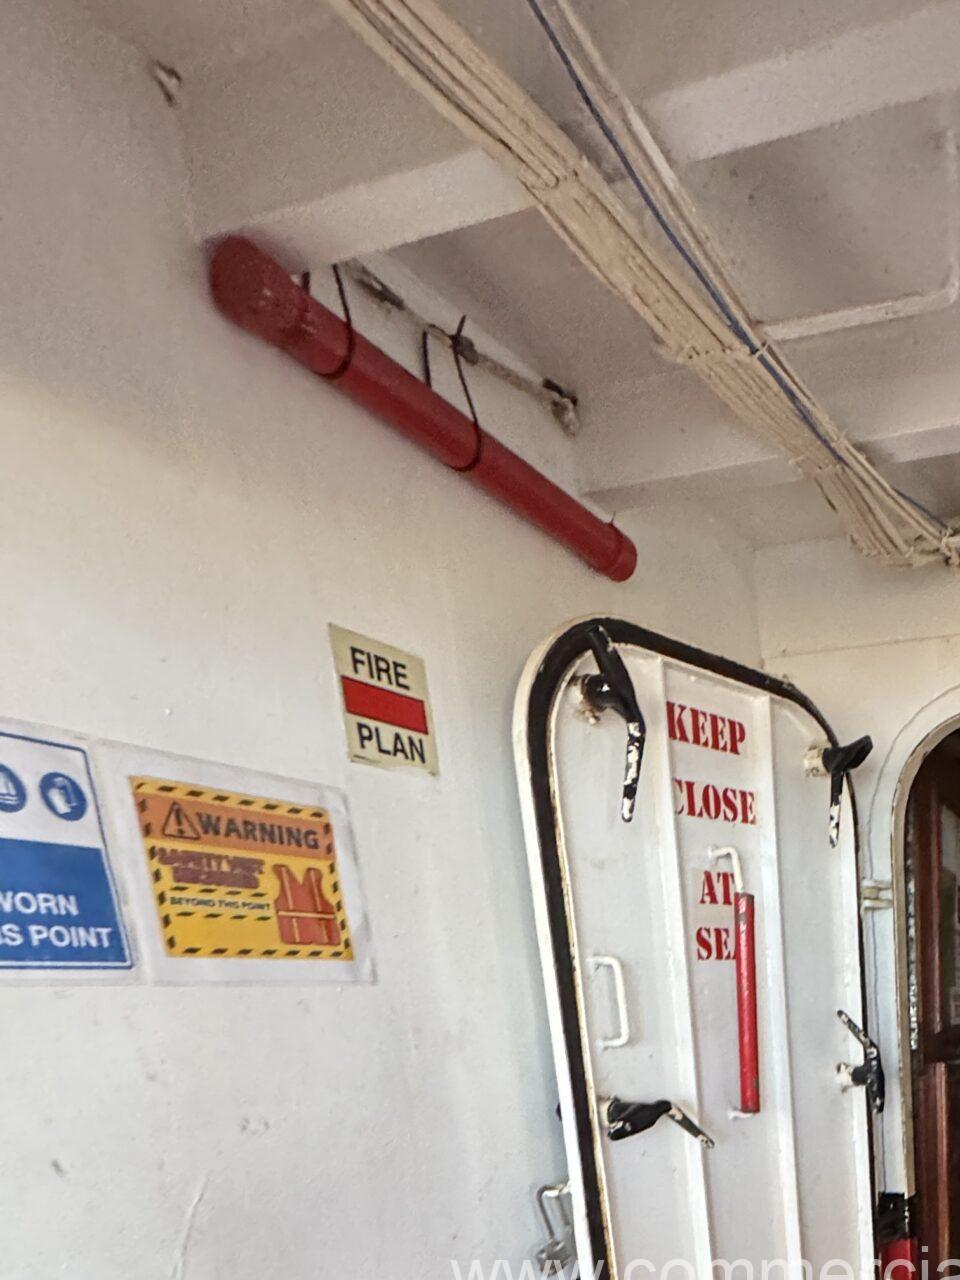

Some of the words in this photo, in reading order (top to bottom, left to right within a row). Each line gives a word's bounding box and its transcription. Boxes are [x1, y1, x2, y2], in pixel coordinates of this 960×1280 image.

[350, 646, 410, 690] FIRE
[357, 722, 426, 764] PLAN
[666, 701, 746, 755] KEEP
[196, 811, 319, 849] WARNING
[700, 870, 735, 905] AT
[29, 924, 112, 949] POINT
[696, 927, 737, 960] SE
